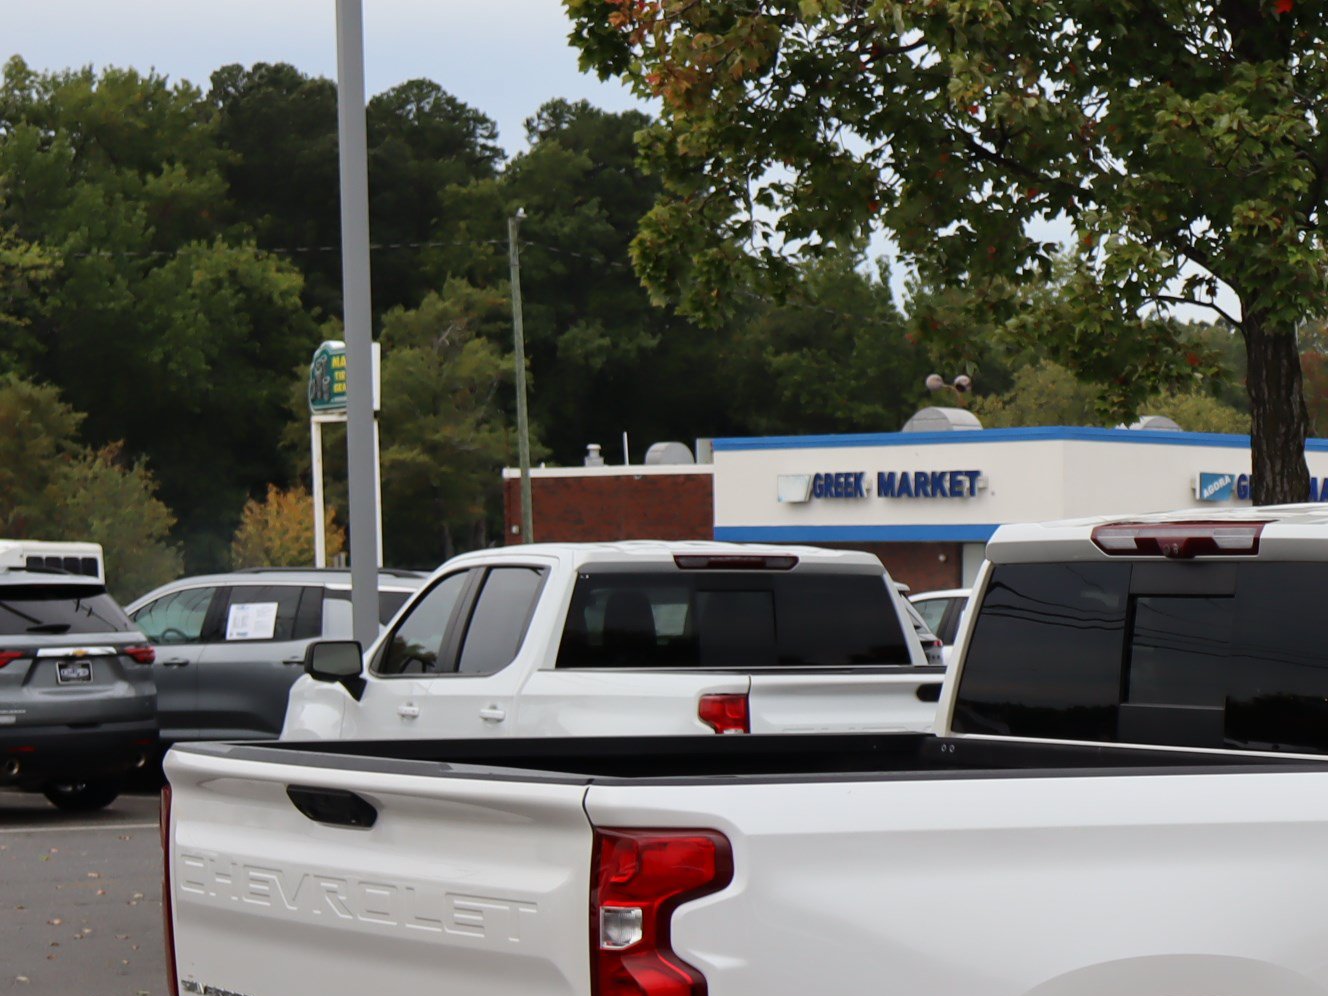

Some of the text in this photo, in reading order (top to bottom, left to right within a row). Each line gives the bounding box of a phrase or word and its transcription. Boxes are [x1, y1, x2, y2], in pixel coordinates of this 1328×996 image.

[812, 470, 981, 498] GREEK MARKET
[1203, 474, 1232, 499] AGORA
[180, 853, 539, 942] CHEVROLET
